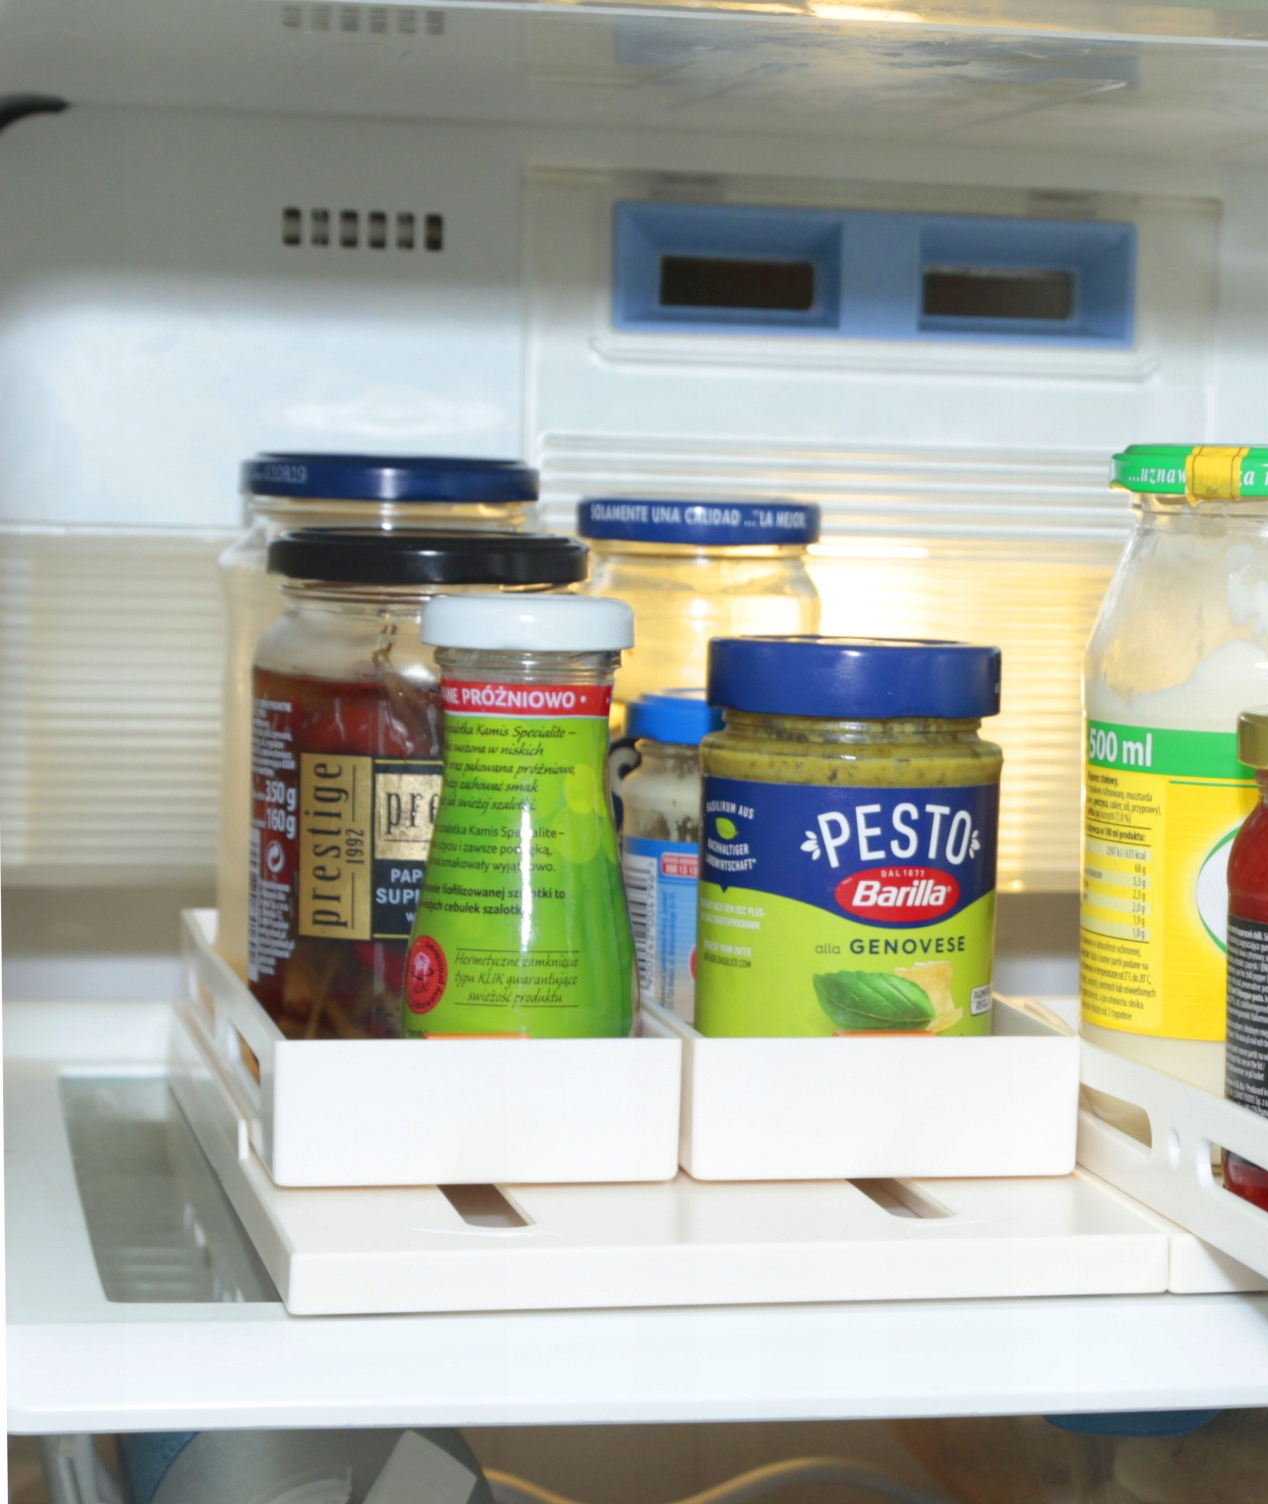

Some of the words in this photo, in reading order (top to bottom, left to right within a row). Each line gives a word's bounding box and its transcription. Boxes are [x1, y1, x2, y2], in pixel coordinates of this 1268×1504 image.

[591, 503, 648, 523] SOLAMENTE
[652, 506, 681, 524] UNA
[684, 507, 741, 526] CALIDAD
[462, 685, 576, 709] PRÓŻNIOWO
[476, 723, 509, 737] Kamis
[511, 725, 566, 743] Specialite
[501, 743, 544, 756] niskich
[1089, 727, 1119, 763] 500
[1122, 732, 1153, 767] ml
[505, 779, 538, 792] smak
[266, 780, 285, 804] 350
[287, 787, 297, 812] g
[386, 792, 439, 835] pre
[739, 805, 755, 820] AUS
[267, 808, 285, 832] 160
[286, 815, 297, 839] g
[469, 825, 499, 837] Kamis
[501, 826, 557, 839] Spealite
[304, 762, 350, 929] prestige
[817, 802, 973, 869] PESTO
[345, 828, 365, 864] 1992
[463, 844, 497, 854] zawsze
[390, 868, 423, 883] PAP
[492, 862, 556, 874] wyjątowo.
[881, 869, 900, 878] DAL
[903, 869, 925, 878] 1877
[555, 888, 566, 900] to
[852, 879, 949, 908] Barilla
[444, 903, 480, 915] cebulek
[482, 905, 531, 916] szalotk
[815, 942, 841, 955] alla
[850, 935, 966, 956] GENOVESE
[478, 971, 505, 986] KLIK
[512, 988, 563, 1008] produktu
